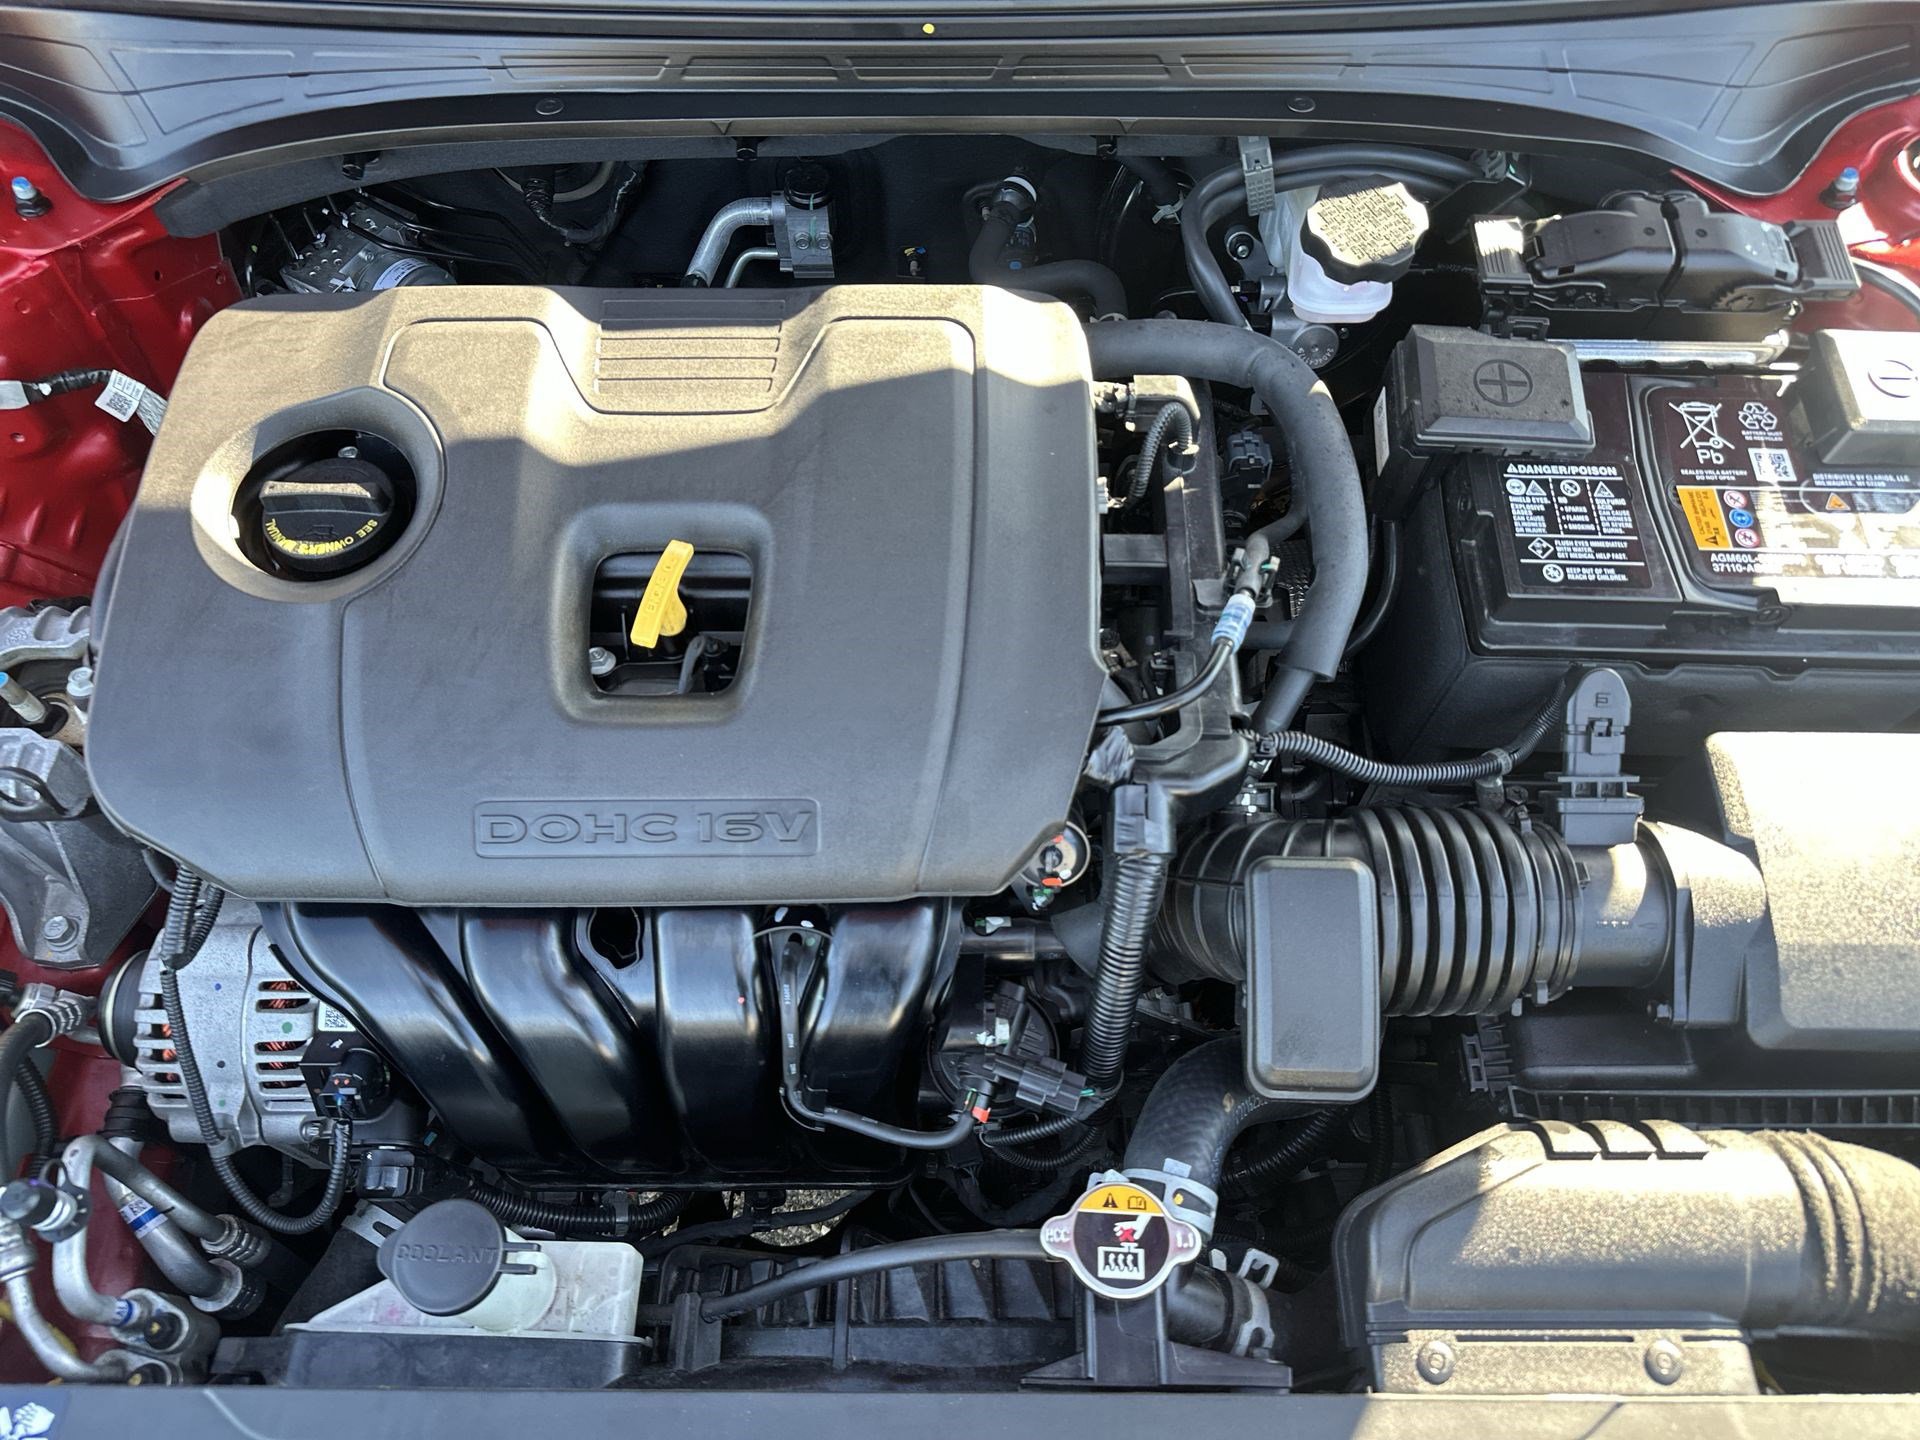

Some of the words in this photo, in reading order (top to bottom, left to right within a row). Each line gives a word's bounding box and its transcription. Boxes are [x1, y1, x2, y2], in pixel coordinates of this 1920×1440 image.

[1697, 449, 1724, 464] Pb
[1518, 464, 1617, 476] DANGER/POISON
[265, 518, 298, 552] MANUAL
[356, 519, 378, 538] SEE
[479, 813, 678, 843] DOHC
[696, 811, 812, 843] 16V
[396, 1243, 499, 1265] COOLANT
